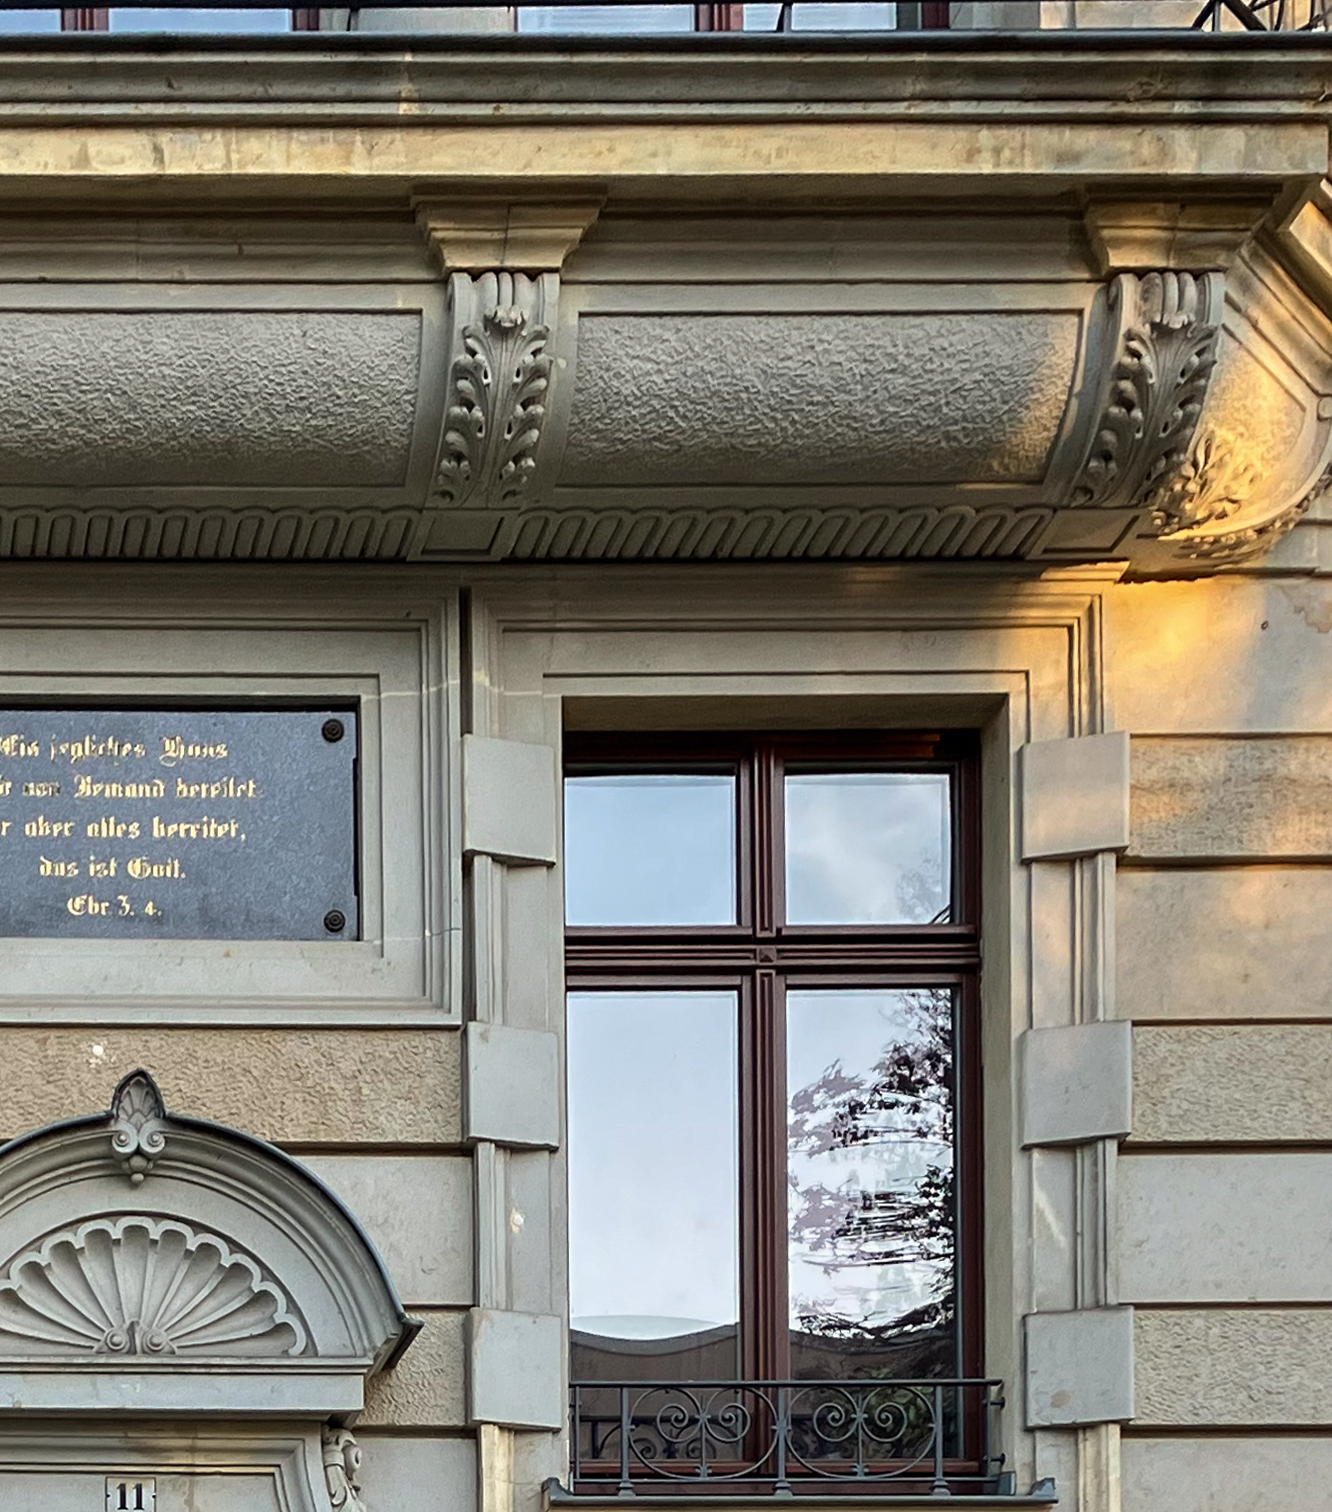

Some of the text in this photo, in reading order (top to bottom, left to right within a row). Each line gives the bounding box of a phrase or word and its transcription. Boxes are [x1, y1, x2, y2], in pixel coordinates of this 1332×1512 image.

[159, 735, 229, 767] Haus
[25, 815, 75, 837] aber
[87, 816, 141, 839] alles
[39, 853, 186, 879] das ist Gott.
[116, 1482, 145, 1511] 11
